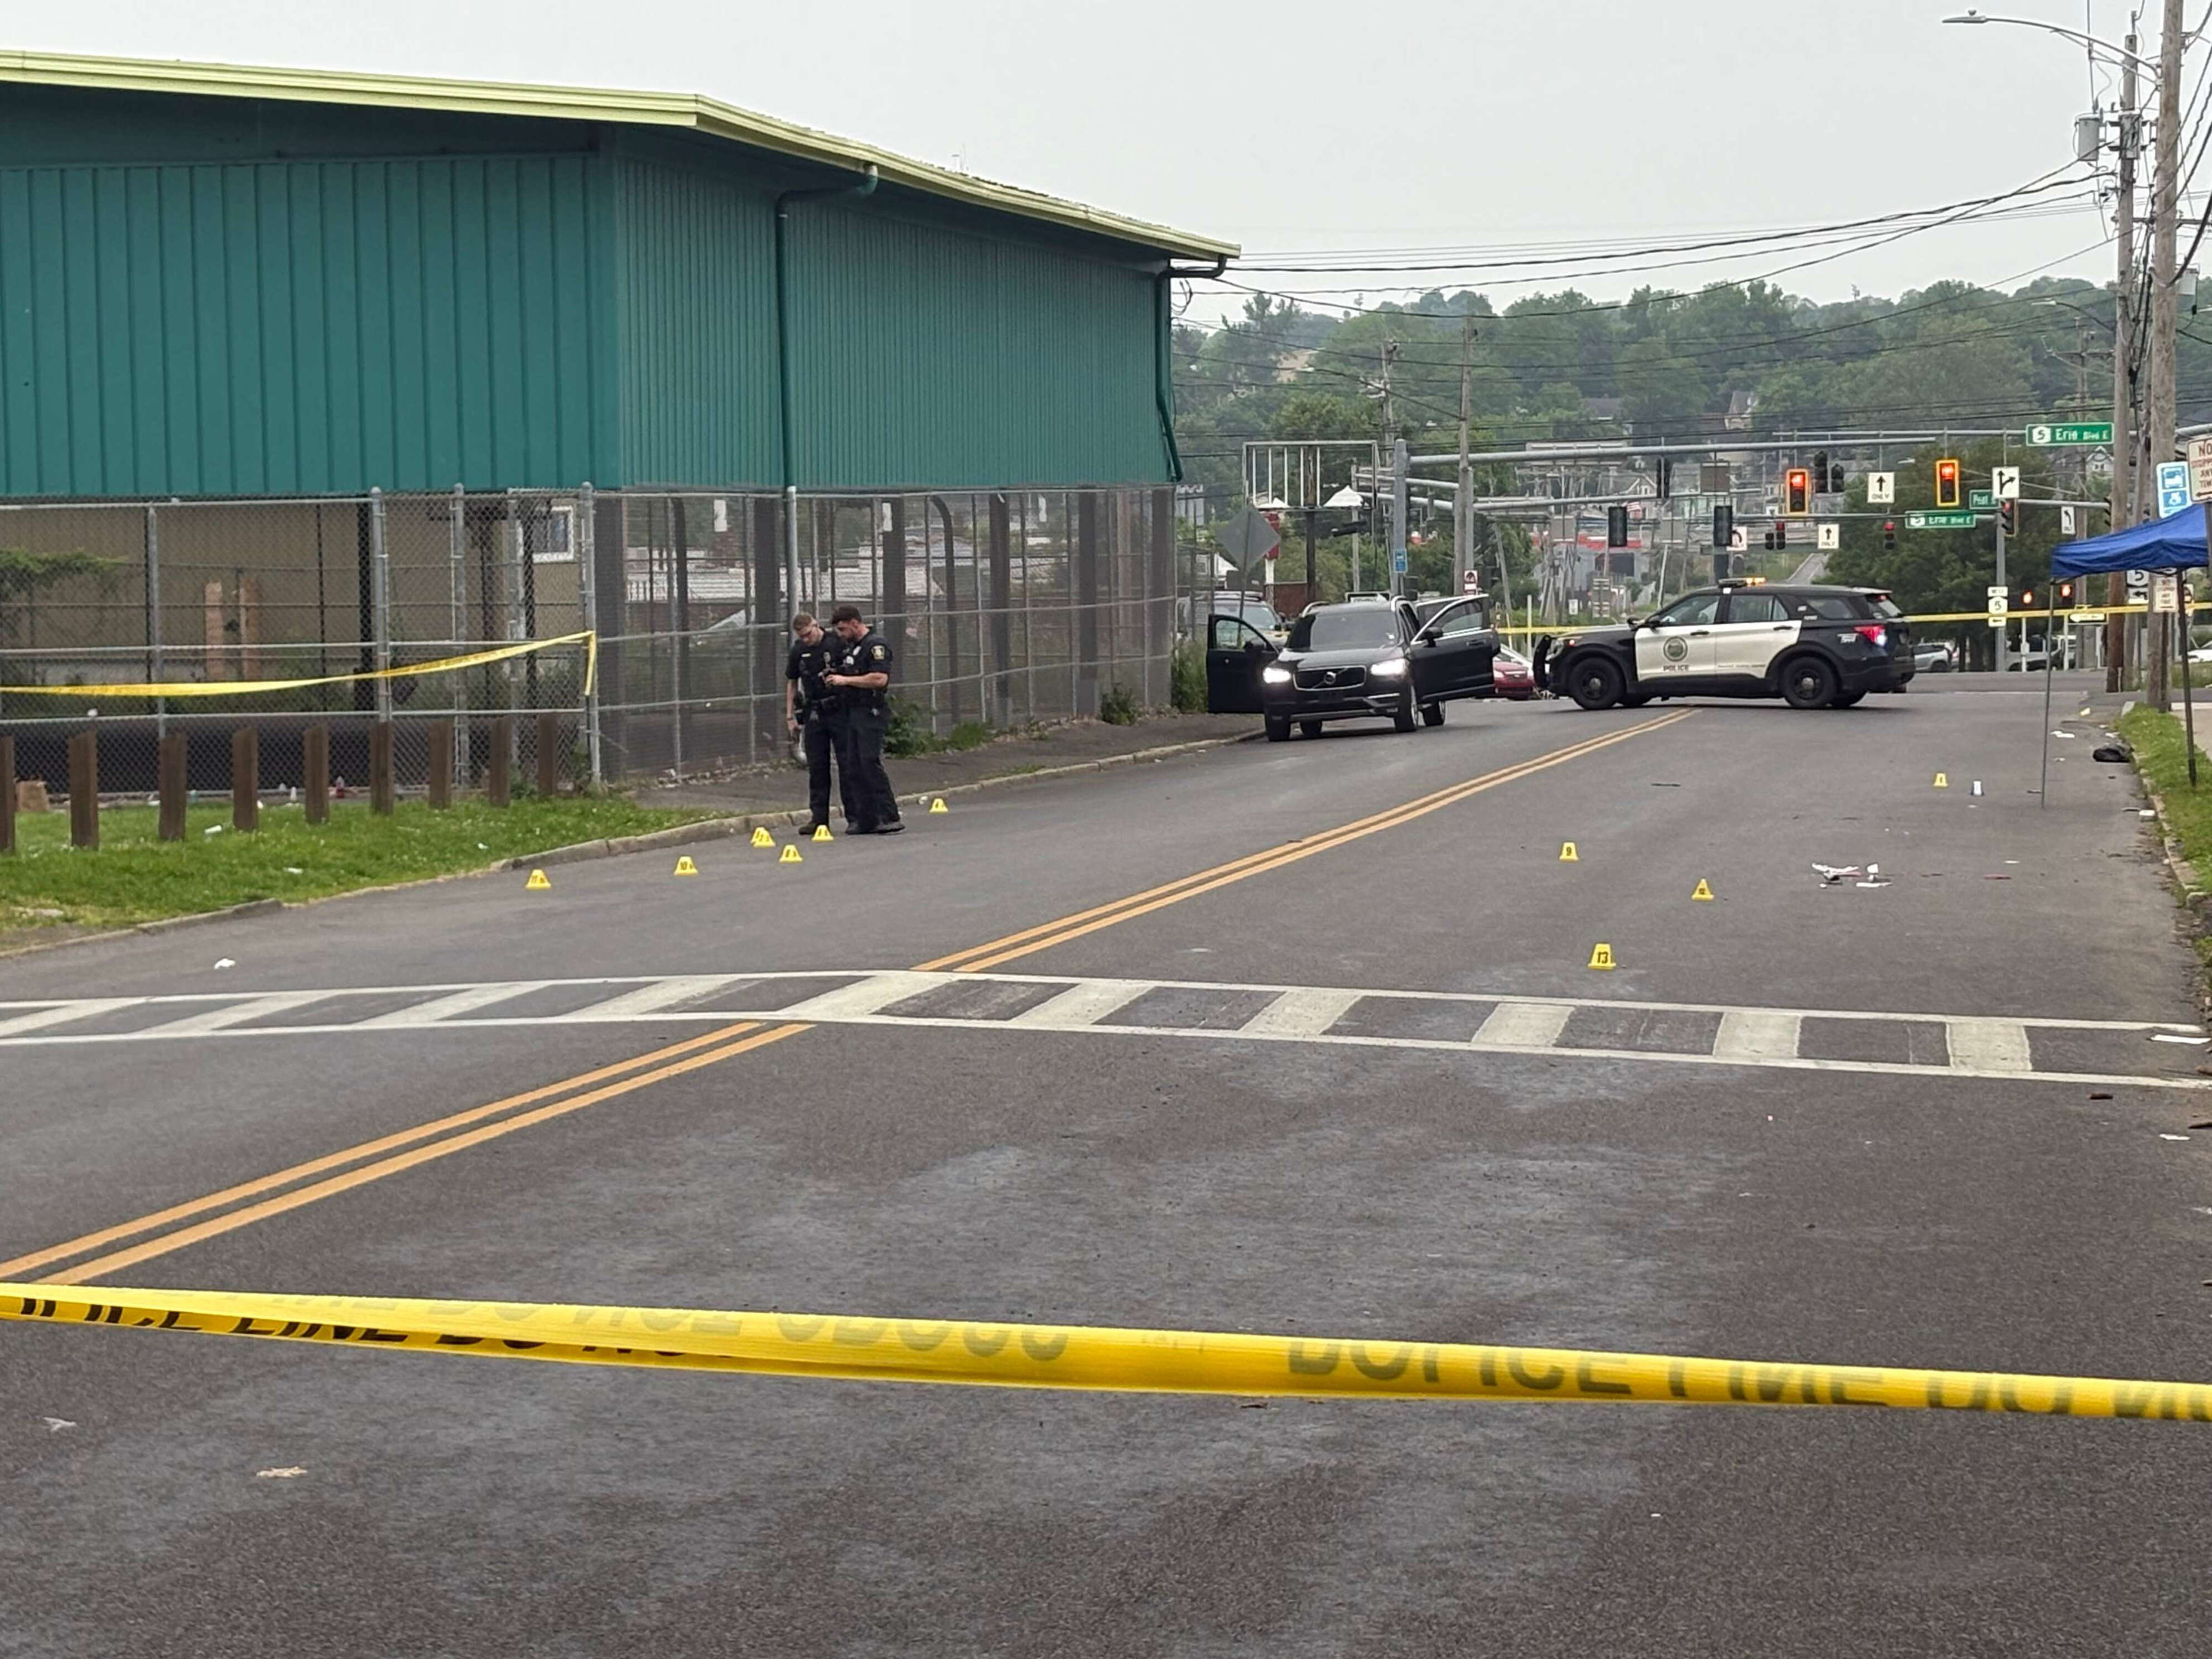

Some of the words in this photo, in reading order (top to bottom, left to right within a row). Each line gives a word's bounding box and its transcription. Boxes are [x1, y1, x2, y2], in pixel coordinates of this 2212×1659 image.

[2055, 428, 2078, 441] Erie
[2102, 430, 2109, 440] E
[2199, 442, 2212, 457] NO
[1994, 600, 2002, 611] 5
[1597, 951, 1608, 964] 13
